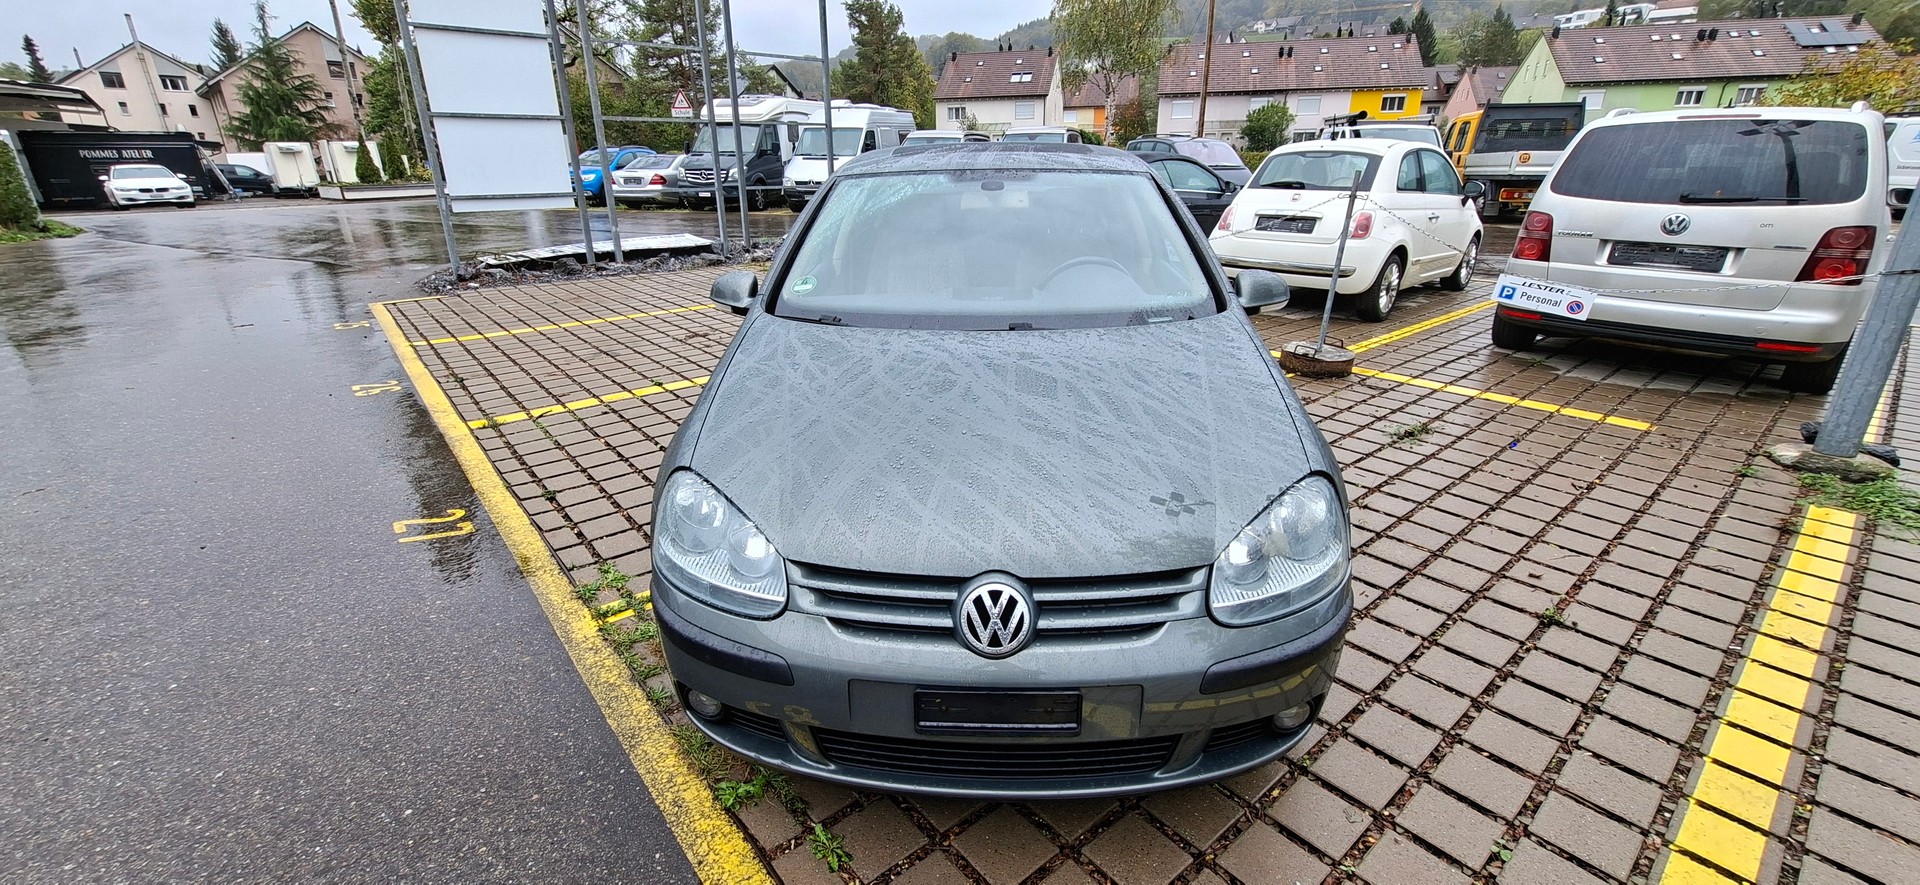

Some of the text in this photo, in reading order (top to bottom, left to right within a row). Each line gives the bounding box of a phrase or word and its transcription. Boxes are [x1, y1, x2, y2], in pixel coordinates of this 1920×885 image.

[78, 149, 154, 159] POMMES ATELIER
[1557, 229, 1594, 238] TOURAN
[1521, 281, 1565, 295] LESTER
[1502, 287, 1513, 297] P
[1519, 292, 1563, 308] Personal
[392, 508, 476, 544] 27
[960, 581, 1031, 654] VW
